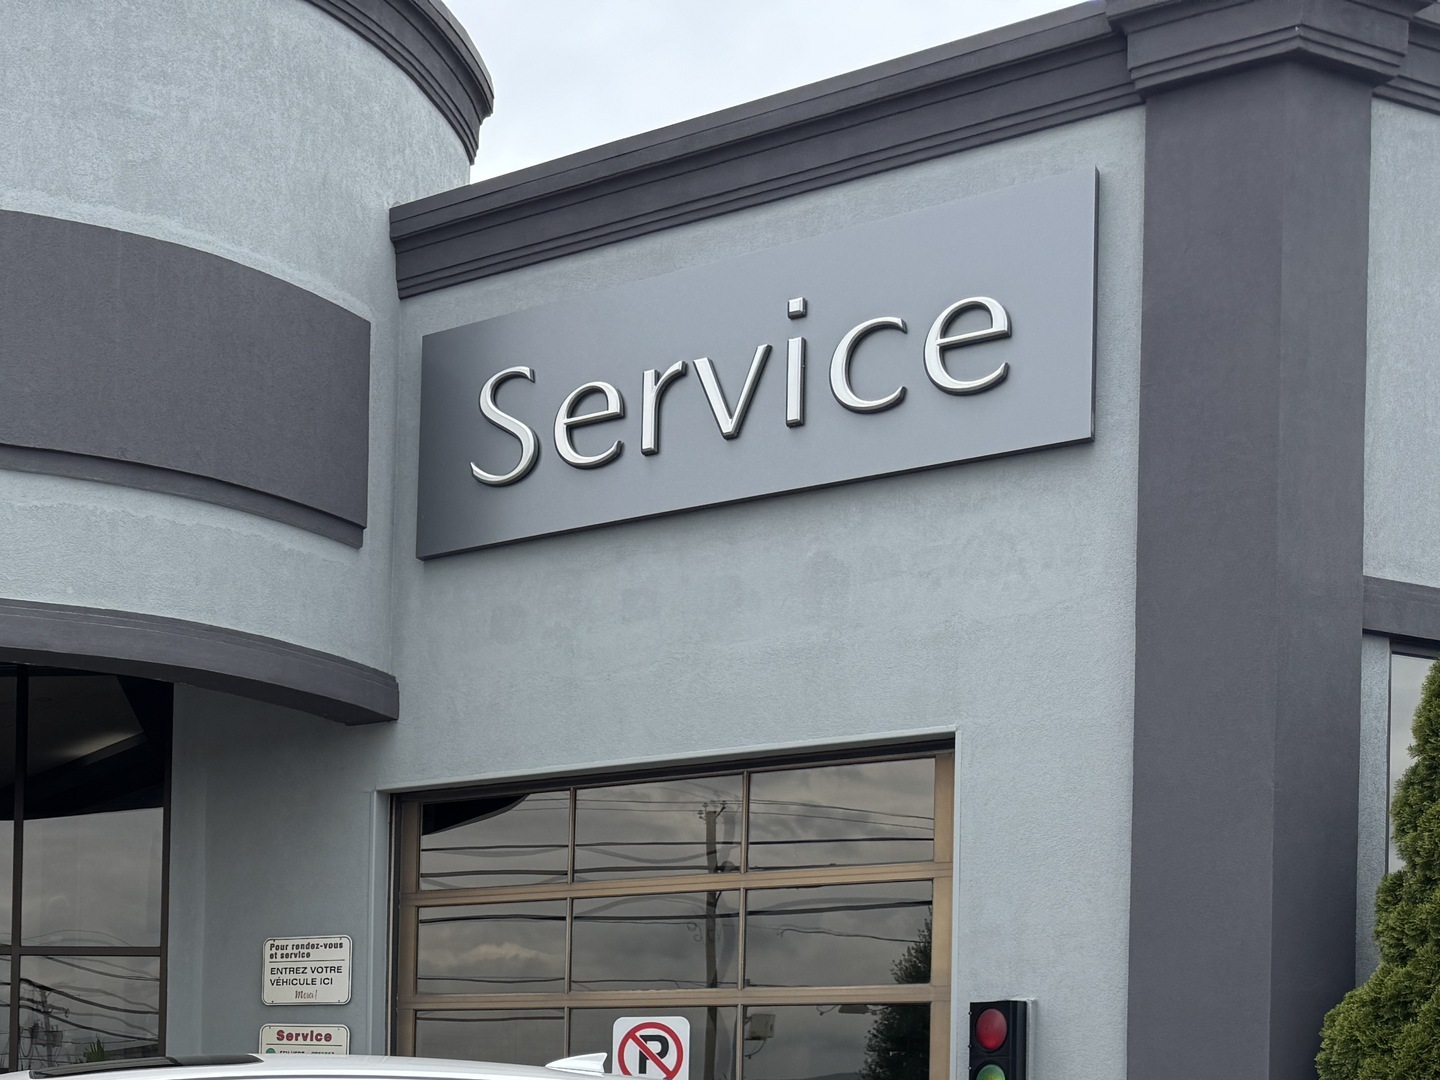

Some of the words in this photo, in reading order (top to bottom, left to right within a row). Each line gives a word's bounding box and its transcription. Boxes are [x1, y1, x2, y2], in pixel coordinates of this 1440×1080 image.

[470, 296, 1012, 486] Service
[269, 943, 289, 951] Pour
[291, 942, 344, 950] rendez-vous
[280, 951, 311, 959] service
[270, 967, 308, 975] ENTREZ
[310, 966, 343, 974] VOTRE
[269, 977, 317, 986] VÉHICULE
[276, 1030, 333, 1042] Service
